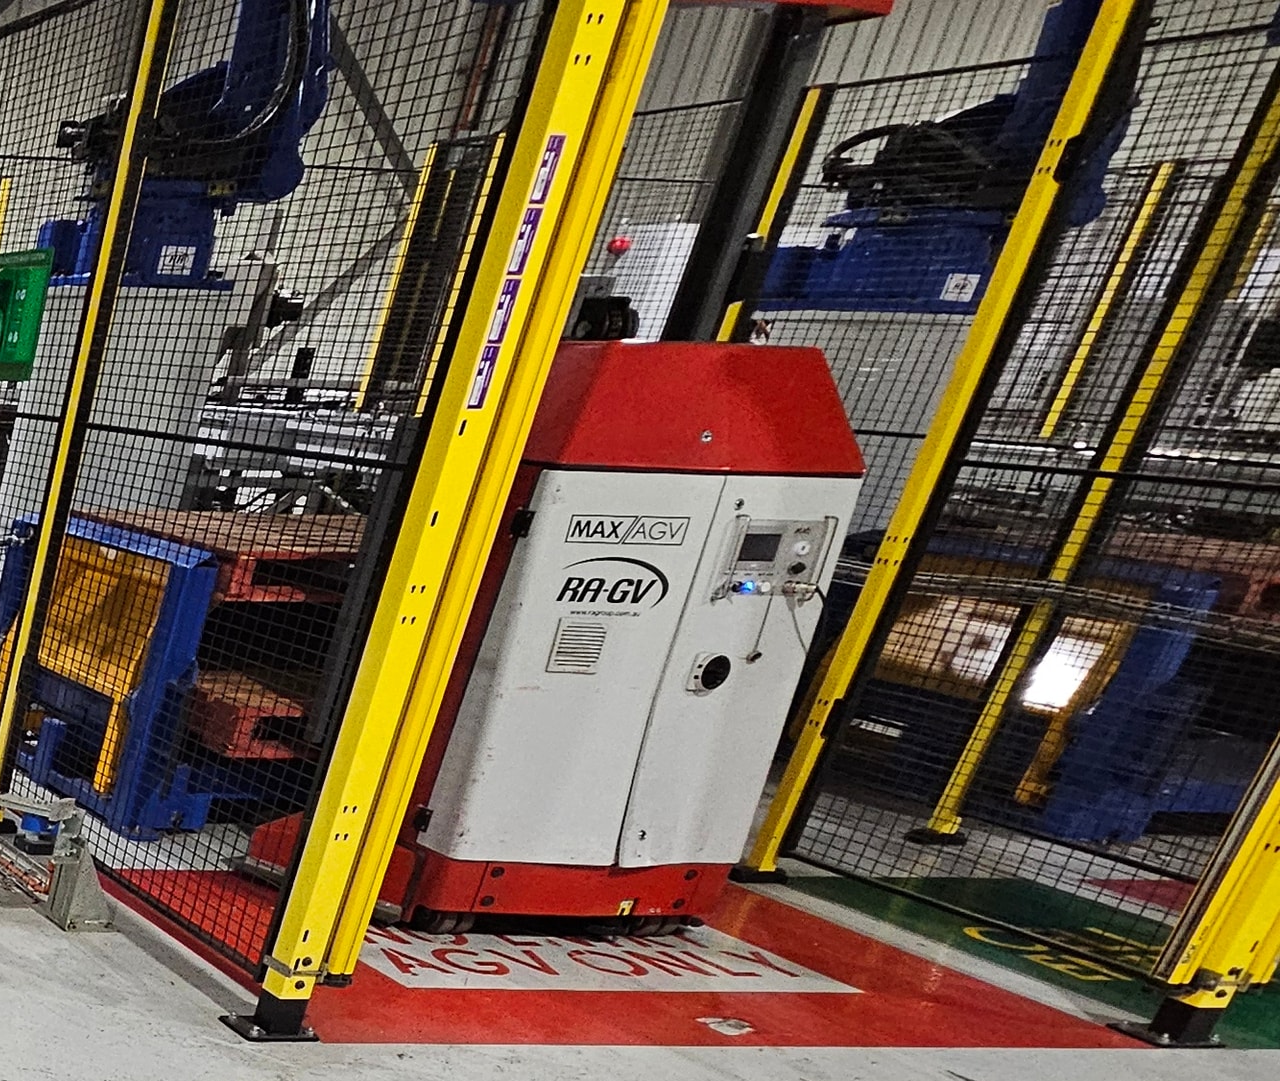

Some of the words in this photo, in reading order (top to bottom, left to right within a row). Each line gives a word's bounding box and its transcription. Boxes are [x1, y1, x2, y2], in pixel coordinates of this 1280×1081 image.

[569, 520, 625, 539] MAX
[629, 520, 685, 541] AGV
[556, 576, 658, 605] RA-GV
[380, 947, 560, 977] AGV
[567, 949, 801, 978] ONLY
